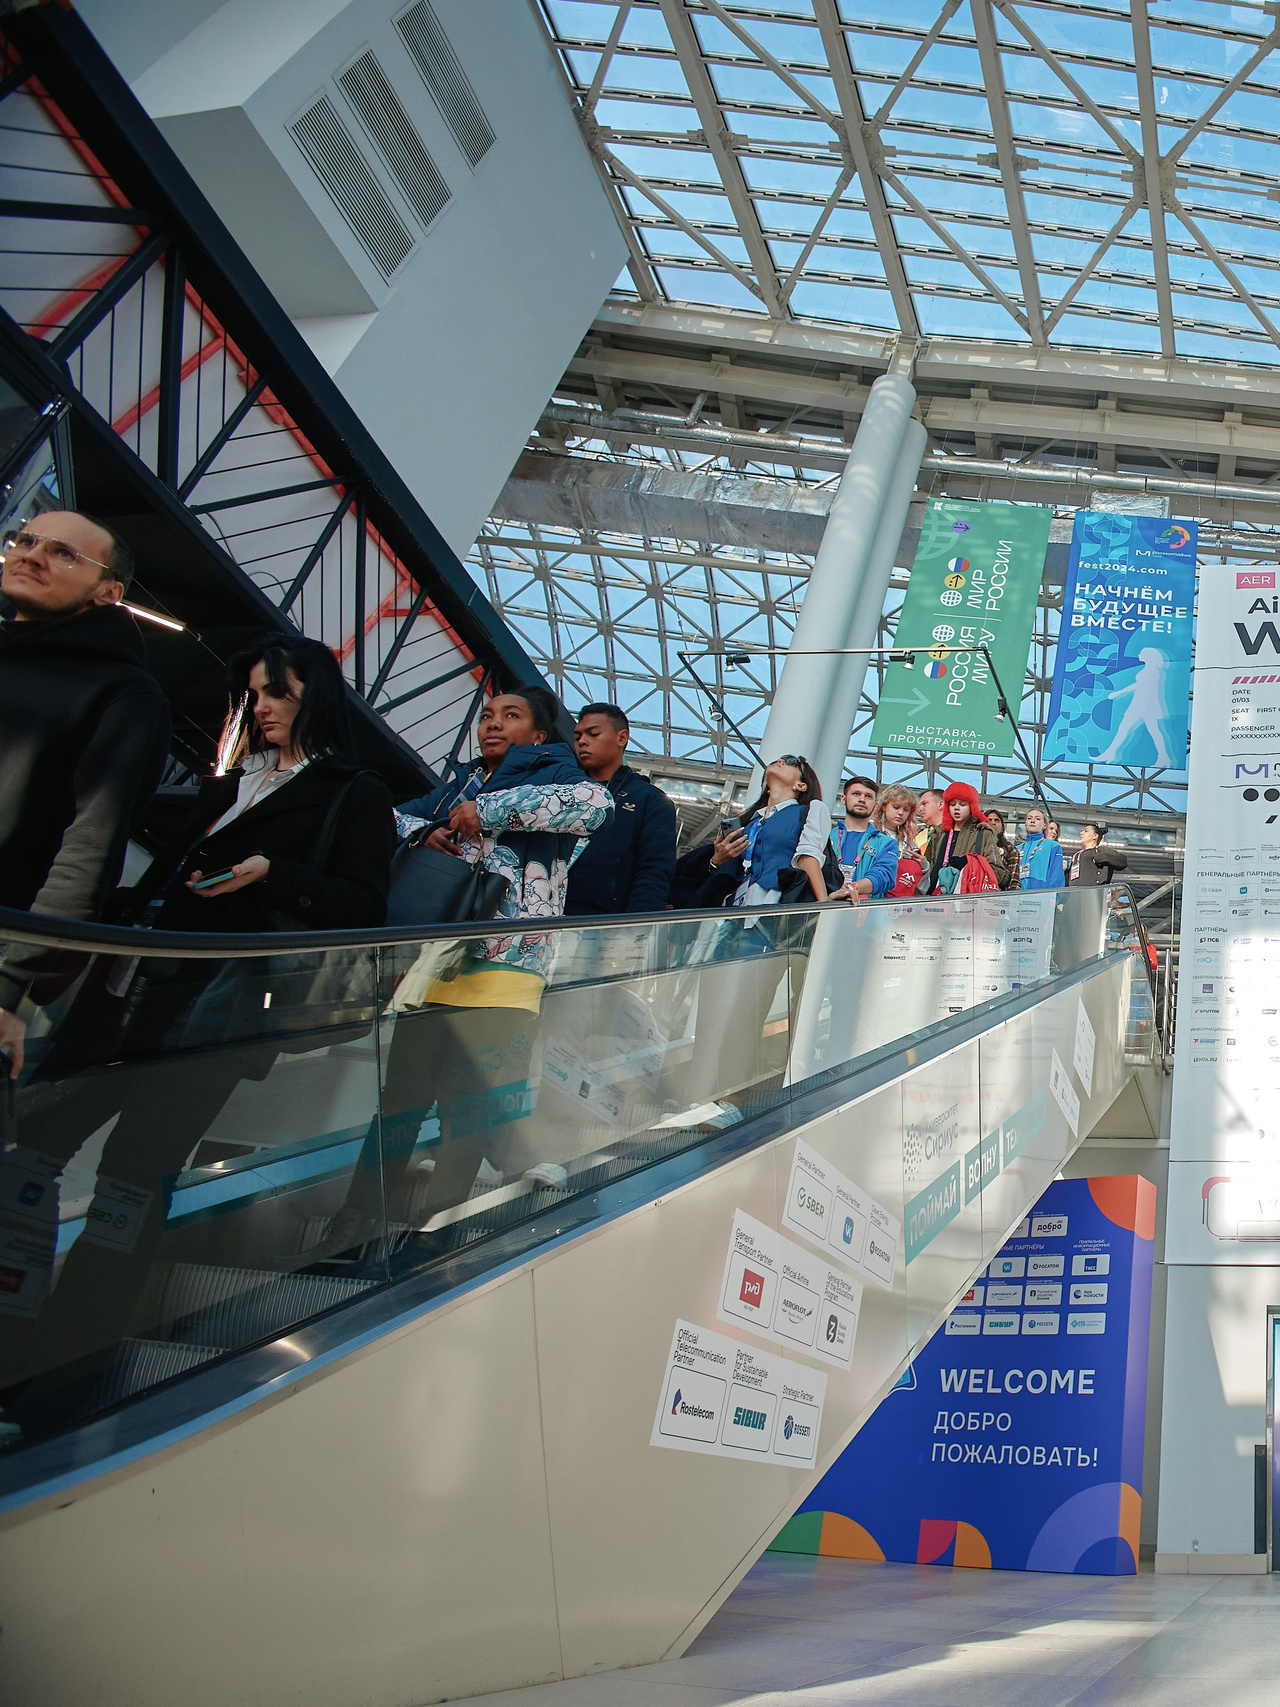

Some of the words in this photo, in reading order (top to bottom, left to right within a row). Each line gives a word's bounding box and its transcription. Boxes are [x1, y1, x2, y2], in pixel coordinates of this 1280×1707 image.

[985, 540, 1013, 611] РОССИИ
[1078, 560, 1168, 576] fest2024.com
[966, 569, 987, 609] МИР
[1240, 576, 1271, 585] AER
[1075, 582, 1173, 602] НАЧНЁМ
[1072, 598, 1188, 619] БУДУЩЕЕ
[1070, 614, 1173, 634] ВМЕСТЕ!
[946, 626, 977, 706] РОССИЯ
[905, 724, 982, 739] ВЫСТАВКА-
[888, 734, 996, 750] ПРОСТРАНСТВО
[924, 1122, 959, 1161] Сириус
[797, 1152, 812, 1170] General
[909, 1174, 957, 1246] ПОЙМАЙ
[968, 1144, 997, 1190] ВОЛНУ
[806, 1196, 825, 1219] SBER
[735, 1227, 755, 1246] General
[734, 1237, 757, 1258] Transport
[757, 1253, 774, 1266] Partner
[782, 1264, 798, 1281] Official
[782, 1298, 807, 1315] AEROFLOT
[678, 1328, 699, 1345] Official
[673, 1351, 695, 1367] Partner
[677, 1339, 727, 1365] Telecommunication
[735, 1349, 754, 1364] Partner
[732, 1369, 763, 1387] Development
[734, 1361, 743, 1370] for
[742, 1362, 768, 1379] Sustainable
[940, 1368, 1096, 1395] WELCOME
[782, 1384, 800, 1400] Strategic
[680, 1401, 715, 1421] Rostelecom
[732, 1406, 767, 1431] SIBUR
[793, 1423, 811, 1437] ROSSETI
[933, 1411, 1012, 1434] ДОБРО
[931, 1442, 1098, 1468] ПОЖАЛОВАТЬ!
